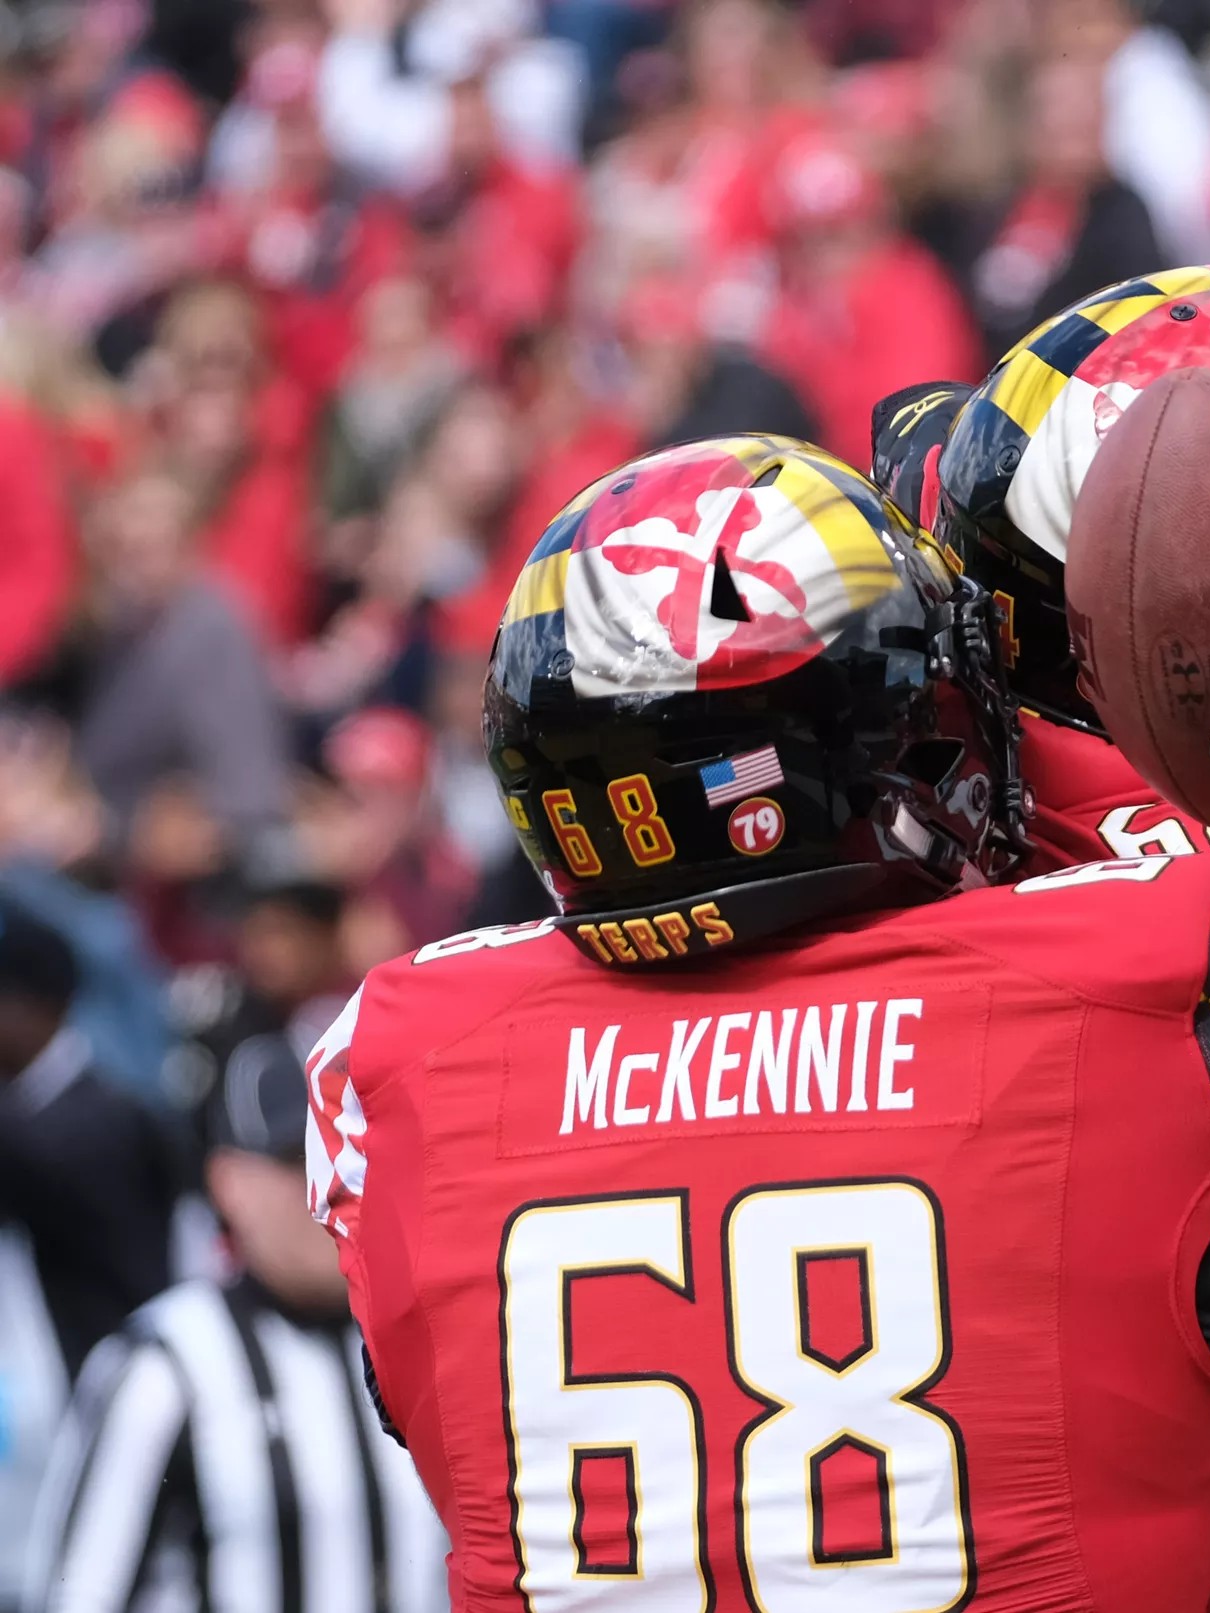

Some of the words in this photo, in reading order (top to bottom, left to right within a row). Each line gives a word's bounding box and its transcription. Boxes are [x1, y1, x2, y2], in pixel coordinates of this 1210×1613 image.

[542, 773, 676, 878] 68
[734, 806, 779, 849] 79
[577, 902, 735, 964] TERPS
[558, 998, 923, 1136] McKENNIE
[497, 1175, 977, 1613] 68
